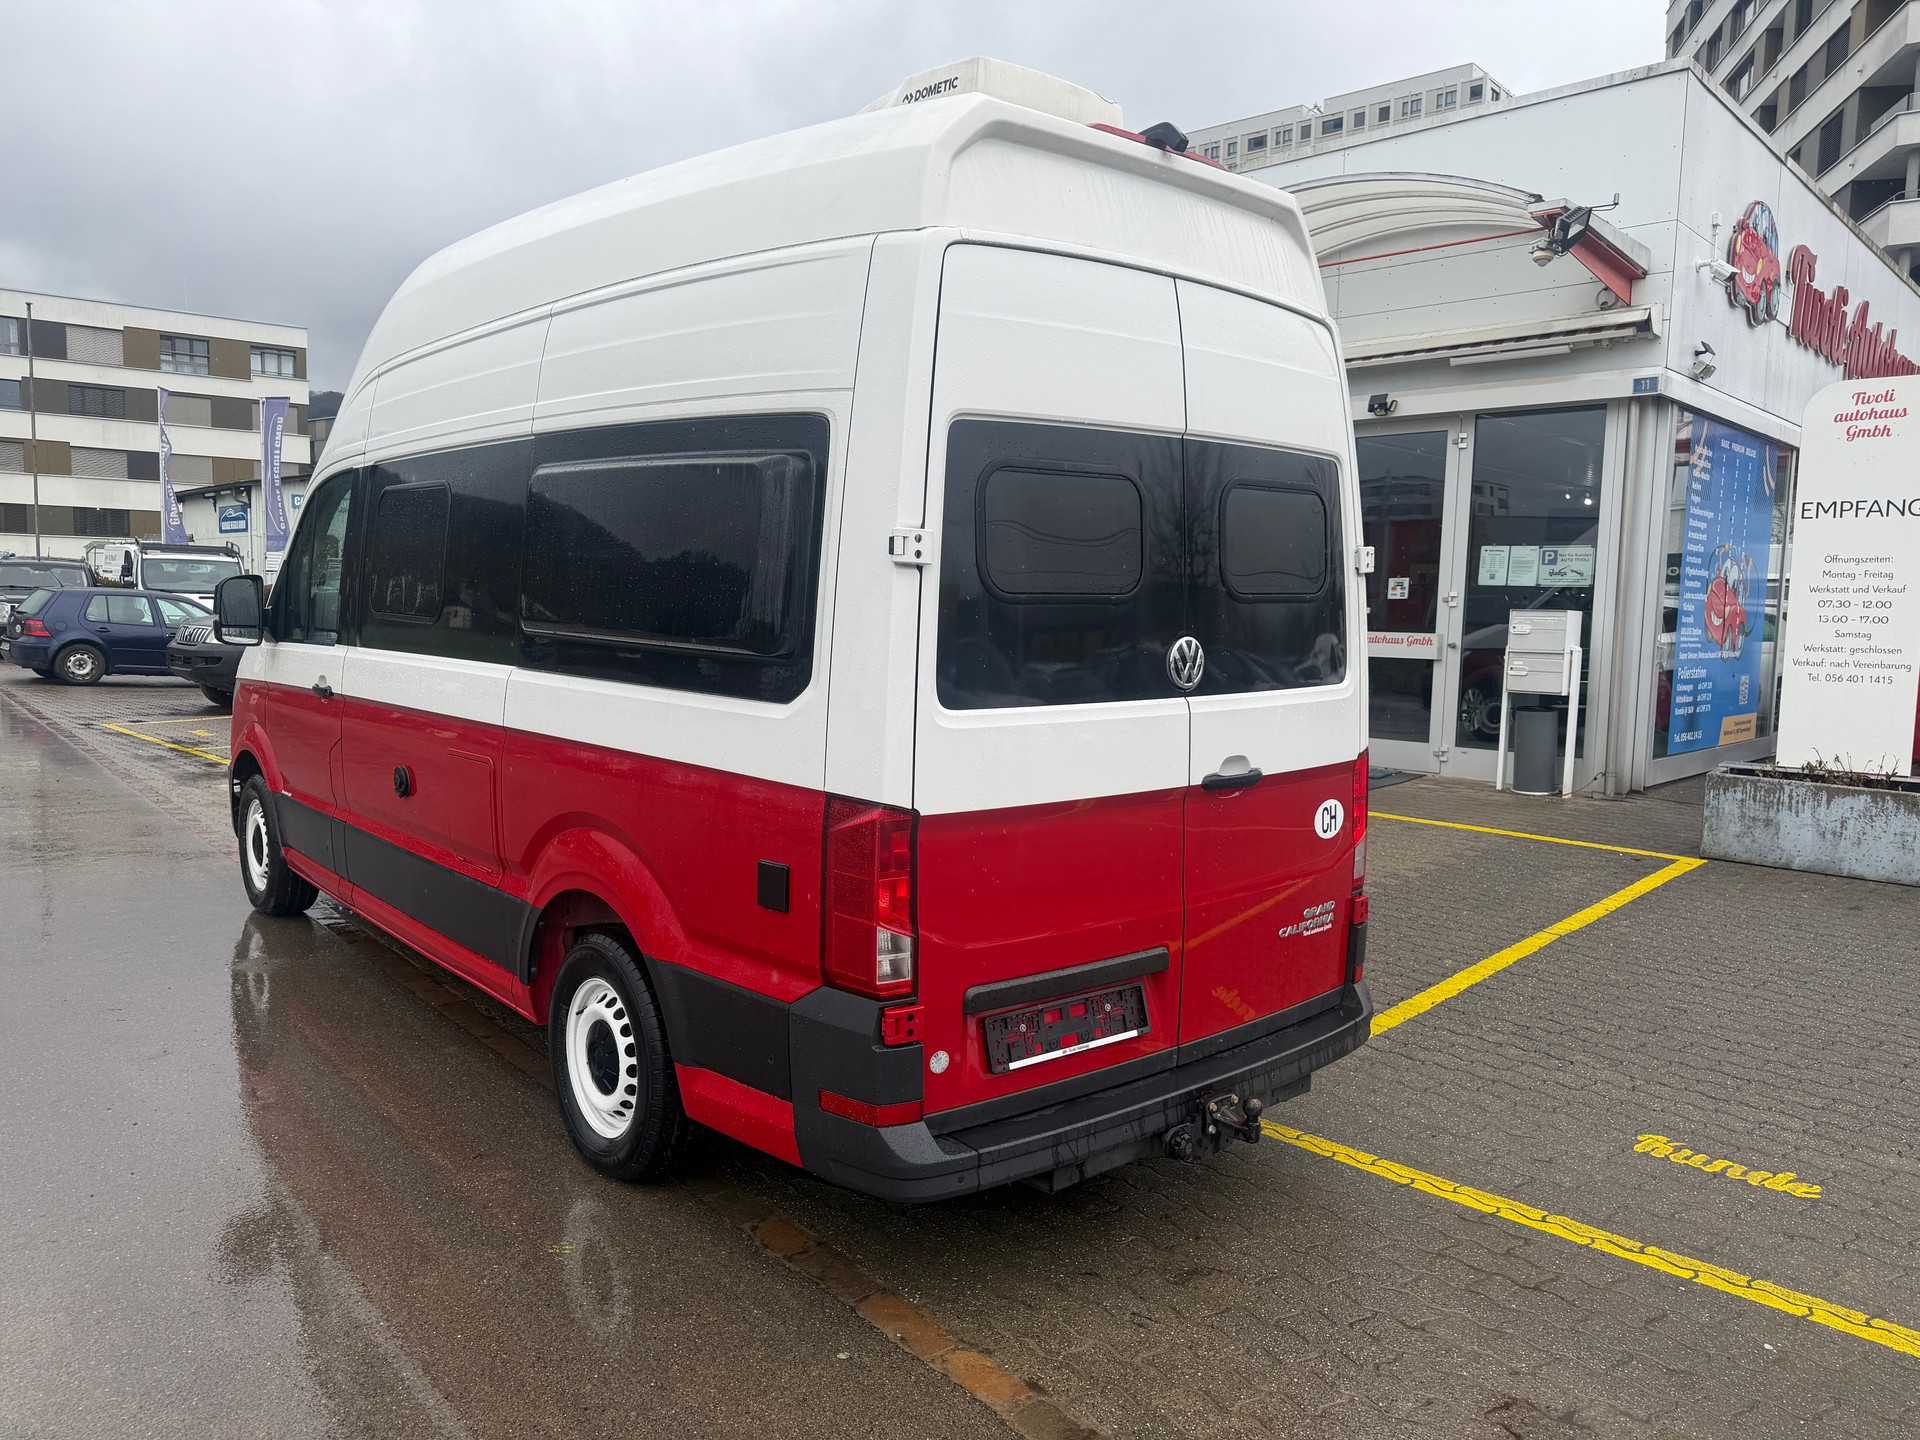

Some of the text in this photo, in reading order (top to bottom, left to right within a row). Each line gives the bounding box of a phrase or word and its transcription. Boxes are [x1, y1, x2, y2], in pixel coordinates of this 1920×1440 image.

[914, 76, 958, 102] DOMETIC
[1789, 244, 1849, 367] Tivoli
[1640, 379, 1650, 390] 11
[1852, 389, 1896, 406] Tivoli
[1834, 407, 1908, 423] autohaus
[1846, 424, 1892, 442] Gmbh
[1801, 498, 1920, 519] EMPFANG
[1824, 553, 1894, 566] Öffnungszeiten:
[1822, 570, 1856, 580] Montag
[1864, 570, 1894, 580] Freitag
[1809, 584, 1907, 594] Werkstatt und Verkauf
[1407, 635, 1433, 647] Gmbh
[1834, 630, 1872, 641] Samstag
[1803, 644, 1903, 655] Werkstatt: geschlossen
[1792, 658, 1912, 672] Verkauf: nach Vereinbarung
[1807, 673, 1822, 682] Tel.
[1825, 674, 1844, 683] 056
[1846, 675, 1864, 684] 401
[1321, 803, 1337, 834] CH
[1303, 900, 1336, 919] GRAND
[1278, 912, 1335, 939] CALIFORNIA
